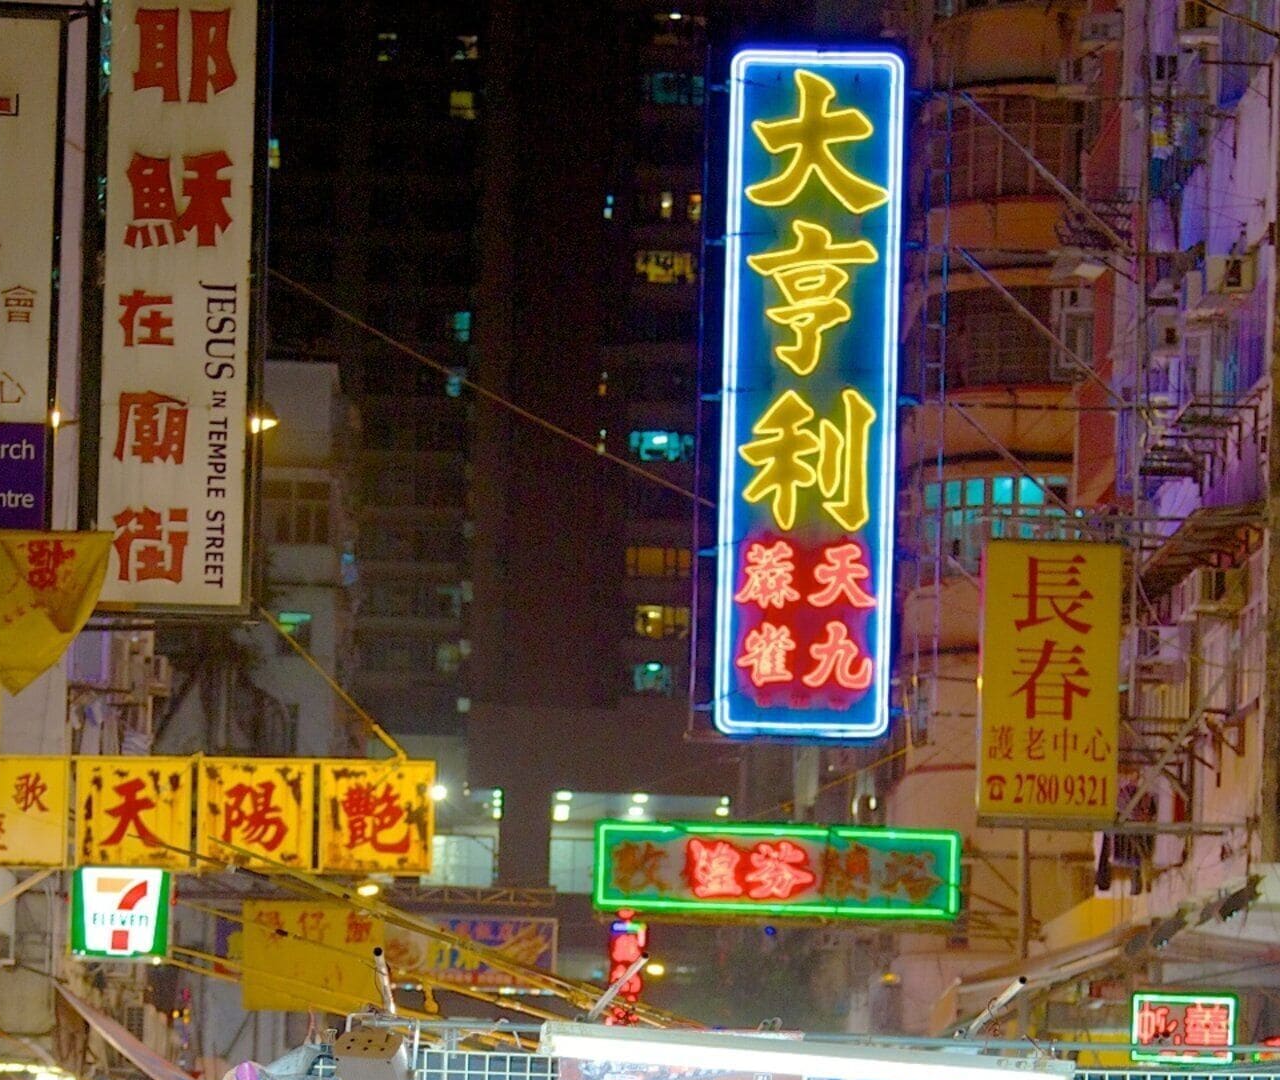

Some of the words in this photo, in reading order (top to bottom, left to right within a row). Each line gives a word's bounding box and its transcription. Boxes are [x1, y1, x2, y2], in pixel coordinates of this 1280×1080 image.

[113, 8, 237, 584] 耶穌在廟街
[199, 280, 237, 380] JESUS
[738, 69, 890, 532] 大亨利
[211, 390, 227, 408] IN
[206, 418, 228, 498] TEMPLE
[204, 510, 225, 589] STREET
[803, 543, 878, 690] 天九
[1011, 555, 1094, 721] 長春
[987, 724, 1111, 763] 護老中心
[1013, 773, 1060, 804] 2780
[1064, 775, 1107, 806] 9321
